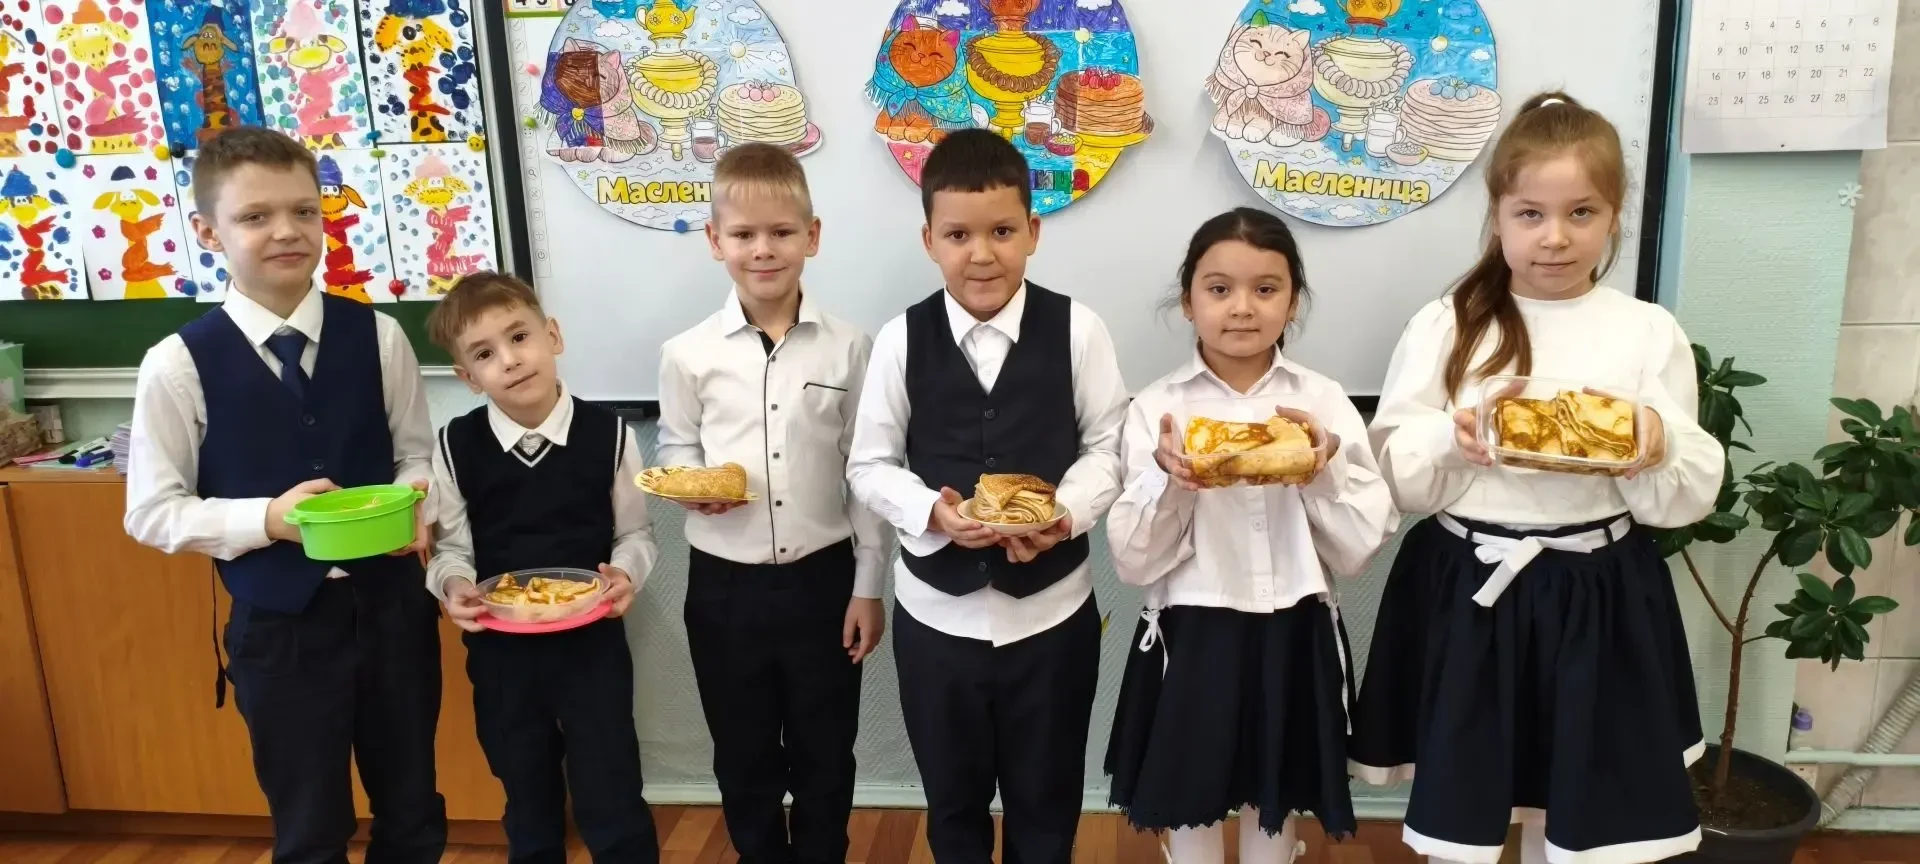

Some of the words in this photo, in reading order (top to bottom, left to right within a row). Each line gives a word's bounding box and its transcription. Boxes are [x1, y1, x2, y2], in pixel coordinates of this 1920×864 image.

[1739, 47, 1748, 56] 10
[1766, 47, 1774, 55] 11
[1790, 46, 1799, 54] 12
[1816, 45, 1825, 54] 13
[1842, 44, 1851, 53] 14
[1868, 43, 1877, 52] 15
[1712, 73, 1721, 81] 16
[1738, 72, 1747, 81] 17
[1762, 71, 1772, 80] 18
[1788, 71, 1797, 79] 19
[1811, 70, 1822, 78] 20
[1838, 69, 1849, 78] 21
[1864, 68, 1875, 77] 22
[1708, 97, 1719, 106] 23
[1734, 97, 1744, 105] 24
[1759, 96, 1770, 105] 25
[1784, 96, 1795, 104] 26
[1811, 95, 1821, 103] 27
[1835, 94, 1846, 103] 28
[1253, 159, 1430, 204] Масленица
[597, 176, 712, 204] Маслен
